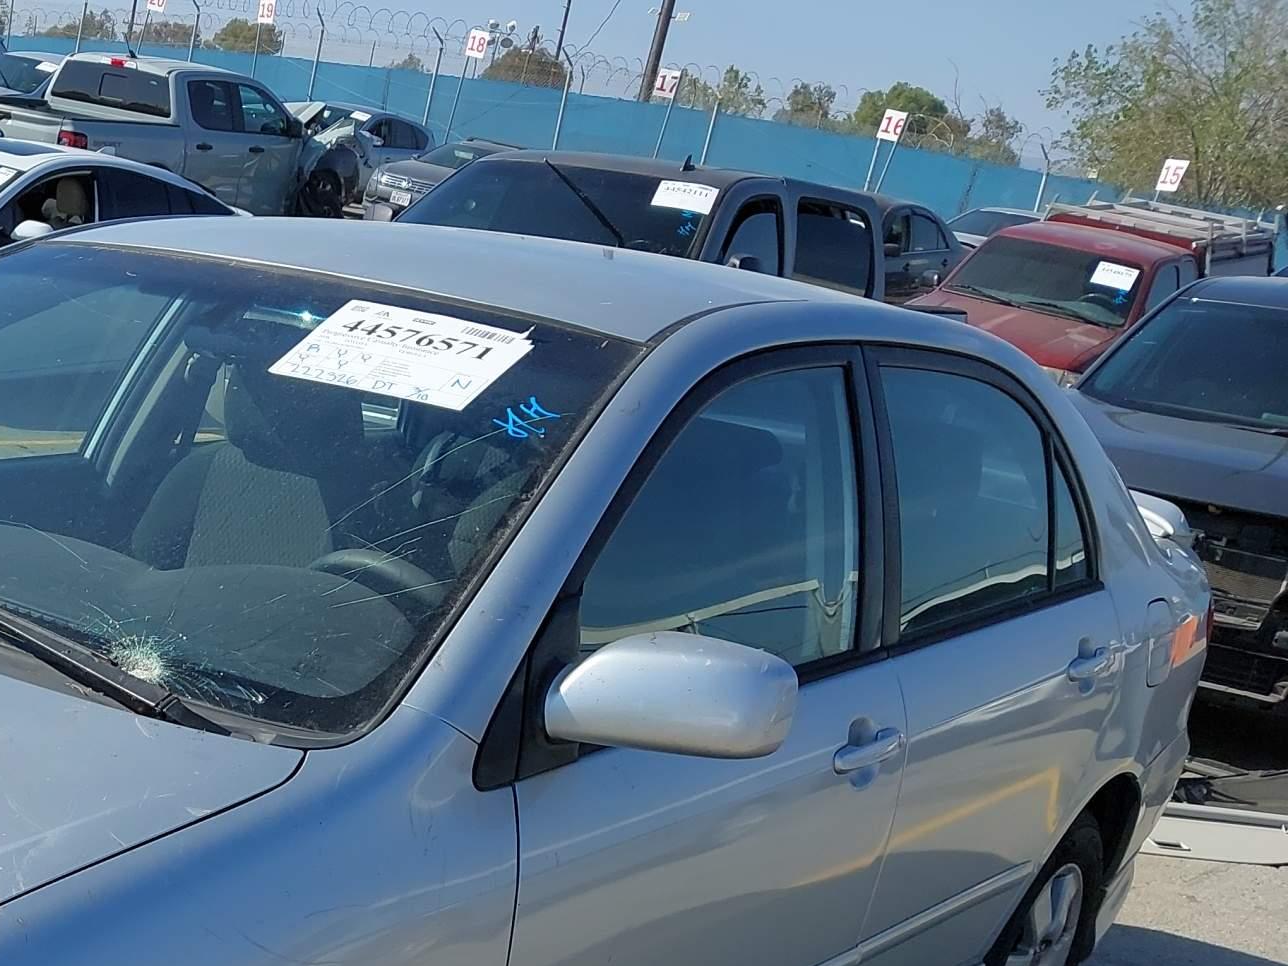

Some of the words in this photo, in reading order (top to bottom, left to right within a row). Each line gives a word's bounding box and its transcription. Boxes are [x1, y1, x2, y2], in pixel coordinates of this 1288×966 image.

[259, 3, 273, 18] 19
[467, 35, 486, 53] 18
[656, 74, 678, 93] 17
[880, 115, 905, 136] 16
[1159, 165, 1184, 185] 15
[342, 319, 494, 360] 44576571
